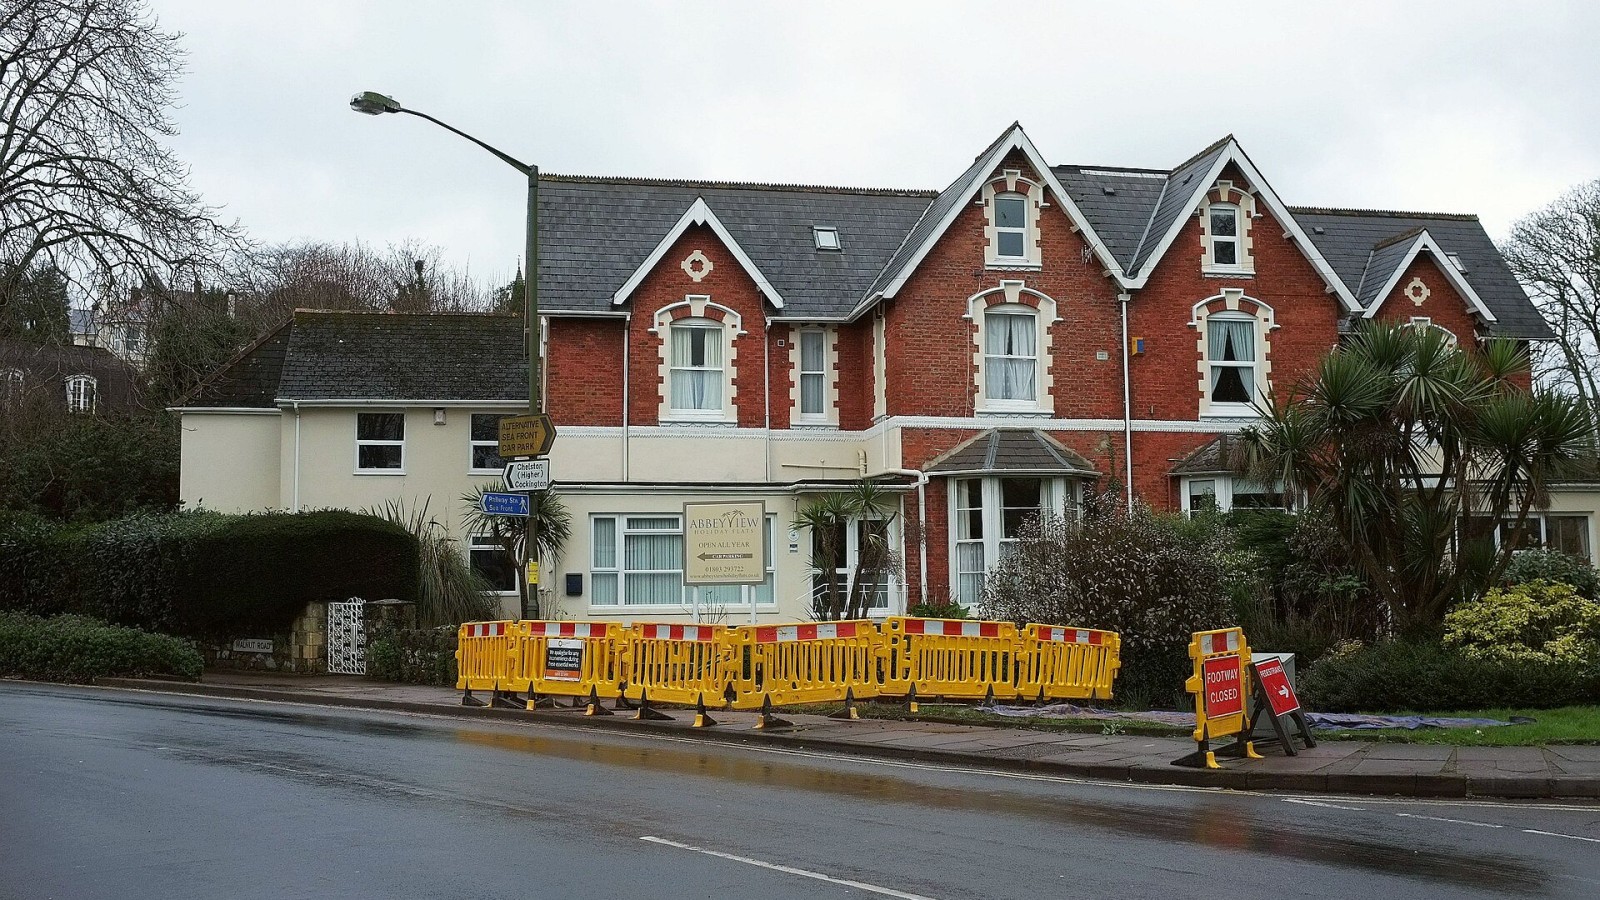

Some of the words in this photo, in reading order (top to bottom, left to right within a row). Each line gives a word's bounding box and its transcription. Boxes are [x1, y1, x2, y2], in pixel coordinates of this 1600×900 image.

[502, 420, 540, 430] ALTERNATIVE
[517, 432, 538, 440] FRONT
[518, 470, 544, 479] (Higher)
[515, 480, 547, 488] Cockington
[1207, 669, 1238, 684] FOOTWAY
[1260, 666, 1282, 677] PEDESTRIANS
[1211, 688, 1237, 703] CLOSED
